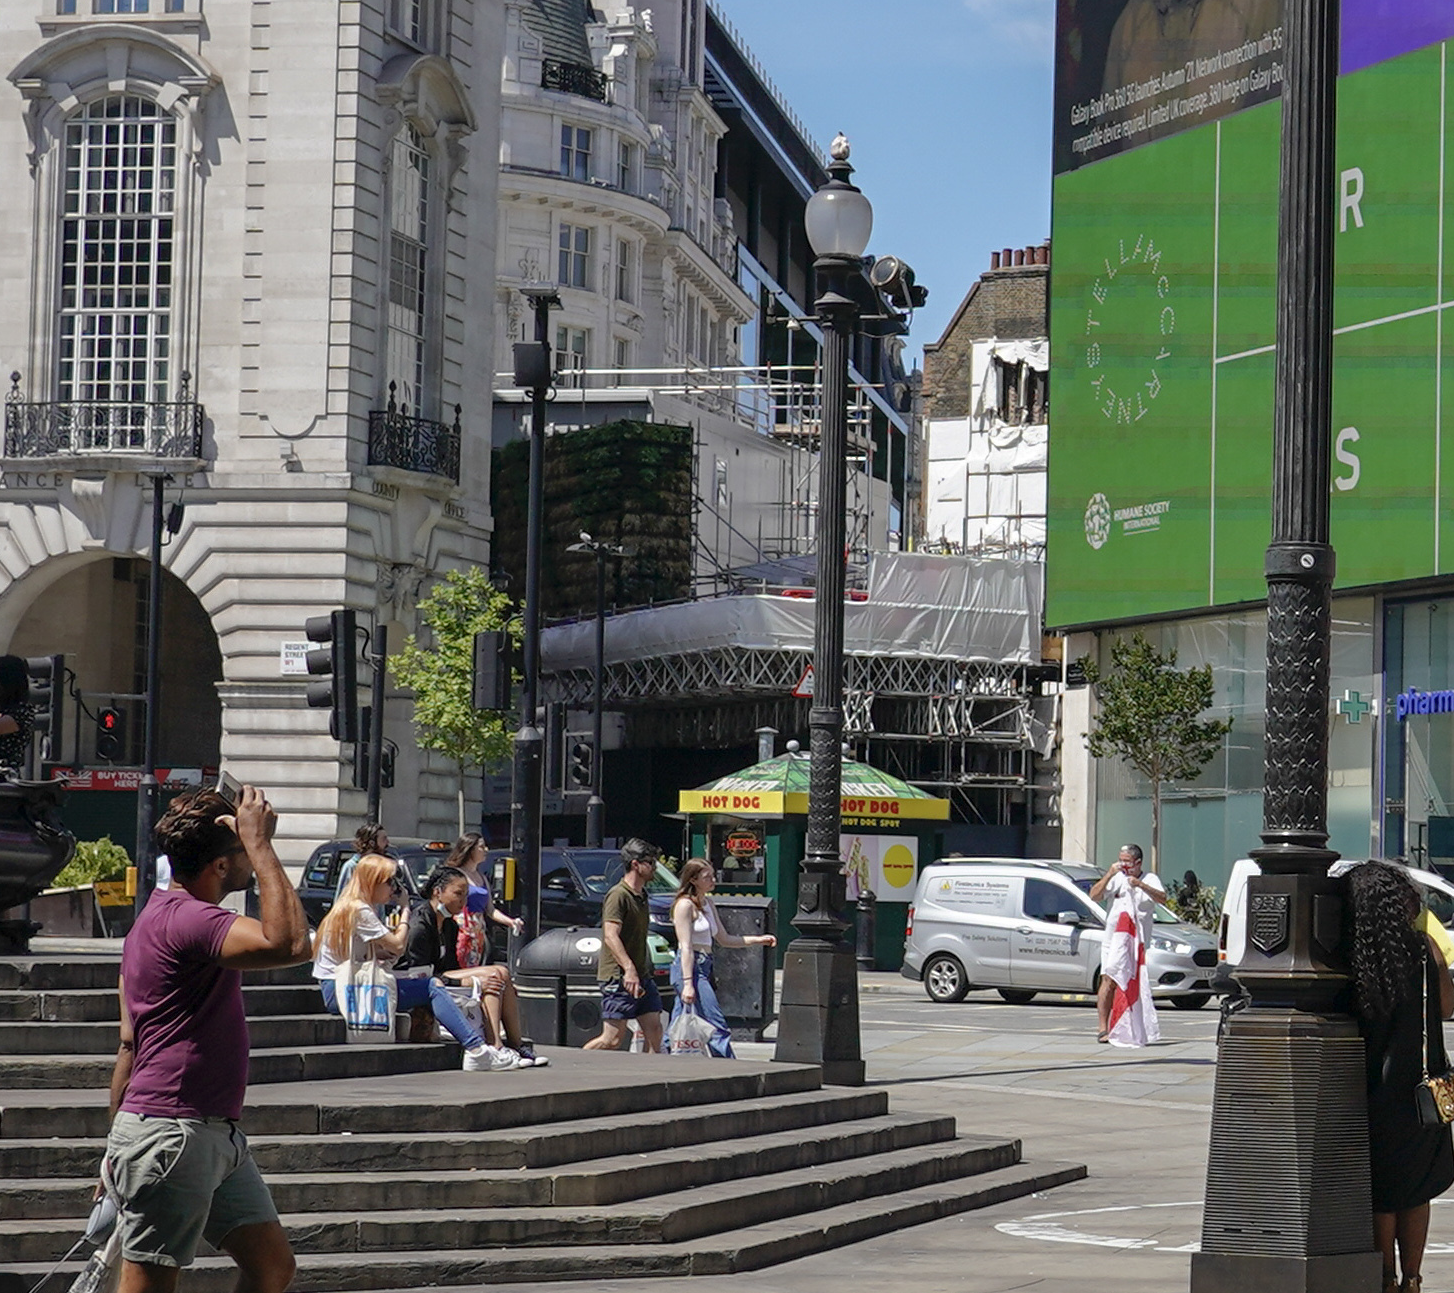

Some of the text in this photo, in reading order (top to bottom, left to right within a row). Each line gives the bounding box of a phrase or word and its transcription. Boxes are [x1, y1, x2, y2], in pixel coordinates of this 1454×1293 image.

[1196, 48, 1222, 79] Network
[1222, 40, 1257, 70] connection
[1257, 32, 1272, 57] with
[1272, 61, 1284, 85] Boo
[135, 474, 194, 487] LE
[1144, 500, 1171, 517] SOCIETY
[97, 771, 145, 780] BUY TICK
[703, 795, 760, 809] HOT DOG
[840, 798, 900, 815] HOT DOG
[842, 817, 901, 828] HOT DOG SPOT
